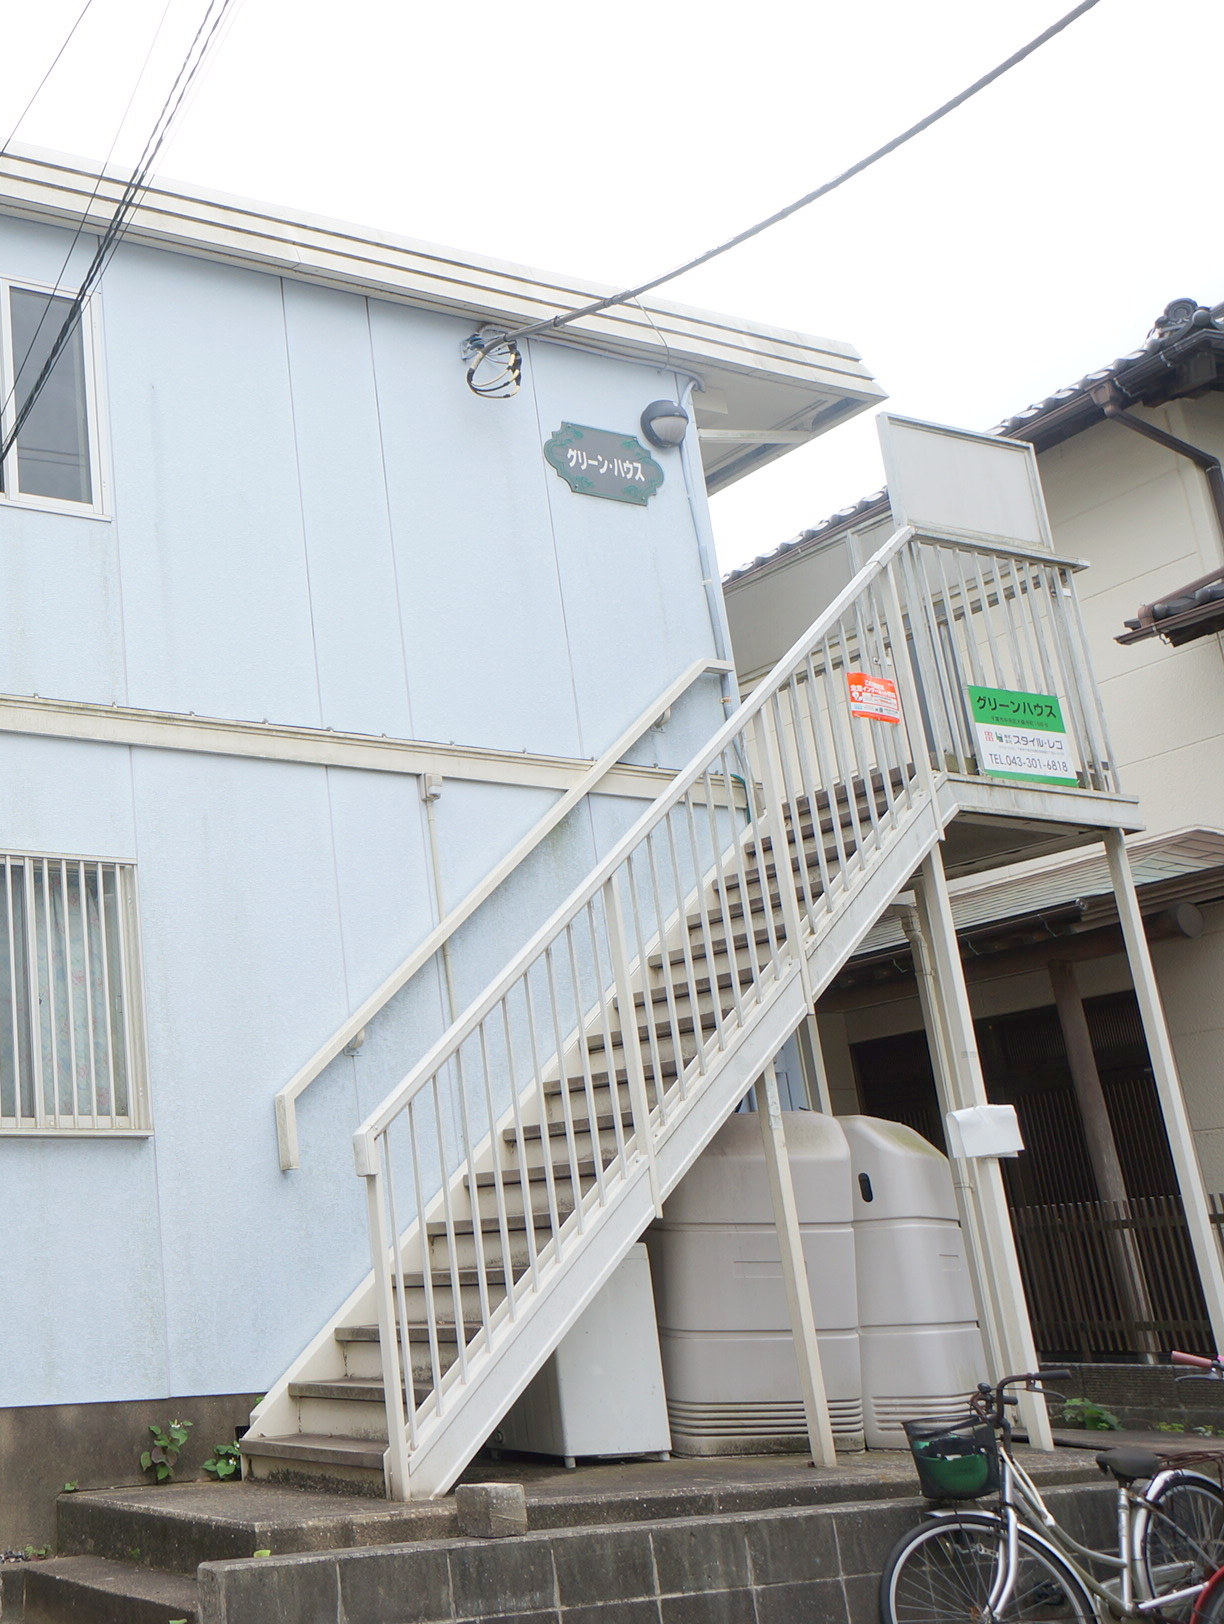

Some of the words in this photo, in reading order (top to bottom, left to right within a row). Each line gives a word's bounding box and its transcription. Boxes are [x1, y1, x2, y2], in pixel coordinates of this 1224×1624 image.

[567, 448, 646, 482] グリーン・ハウス
[976, 696, 1057, 719] グリーンハウス
[989, 753, 1068, 772] TEL.043-301-6818
